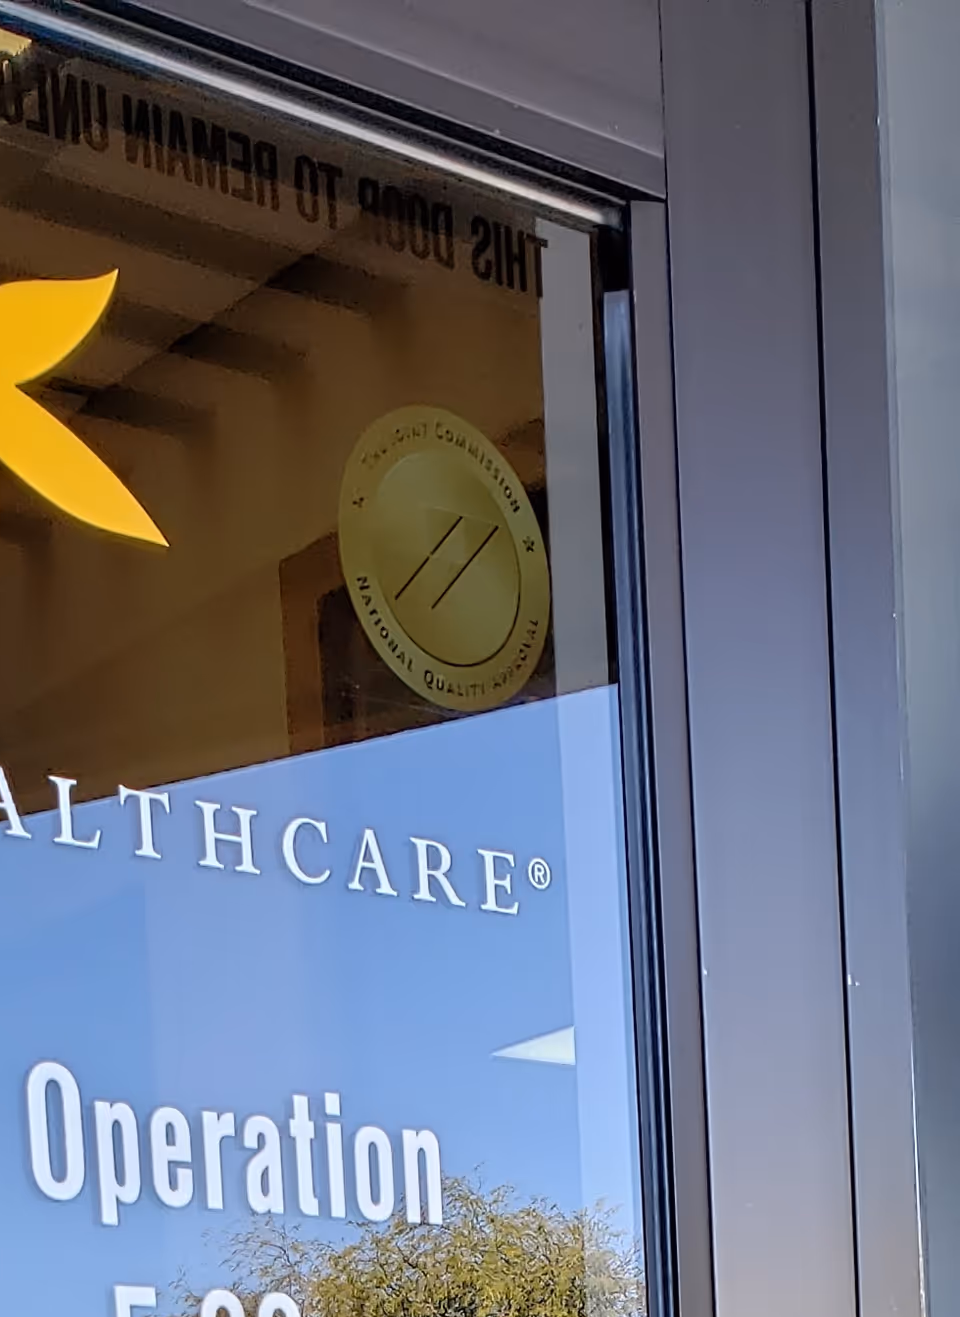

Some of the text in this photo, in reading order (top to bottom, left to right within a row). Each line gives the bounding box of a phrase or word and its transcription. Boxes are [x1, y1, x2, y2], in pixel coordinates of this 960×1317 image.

[434, 421, 522, 514] COMMISSION
[356, 575, 415, 673] NATIONAL
[25, 1059, 444, 1227] Operation
